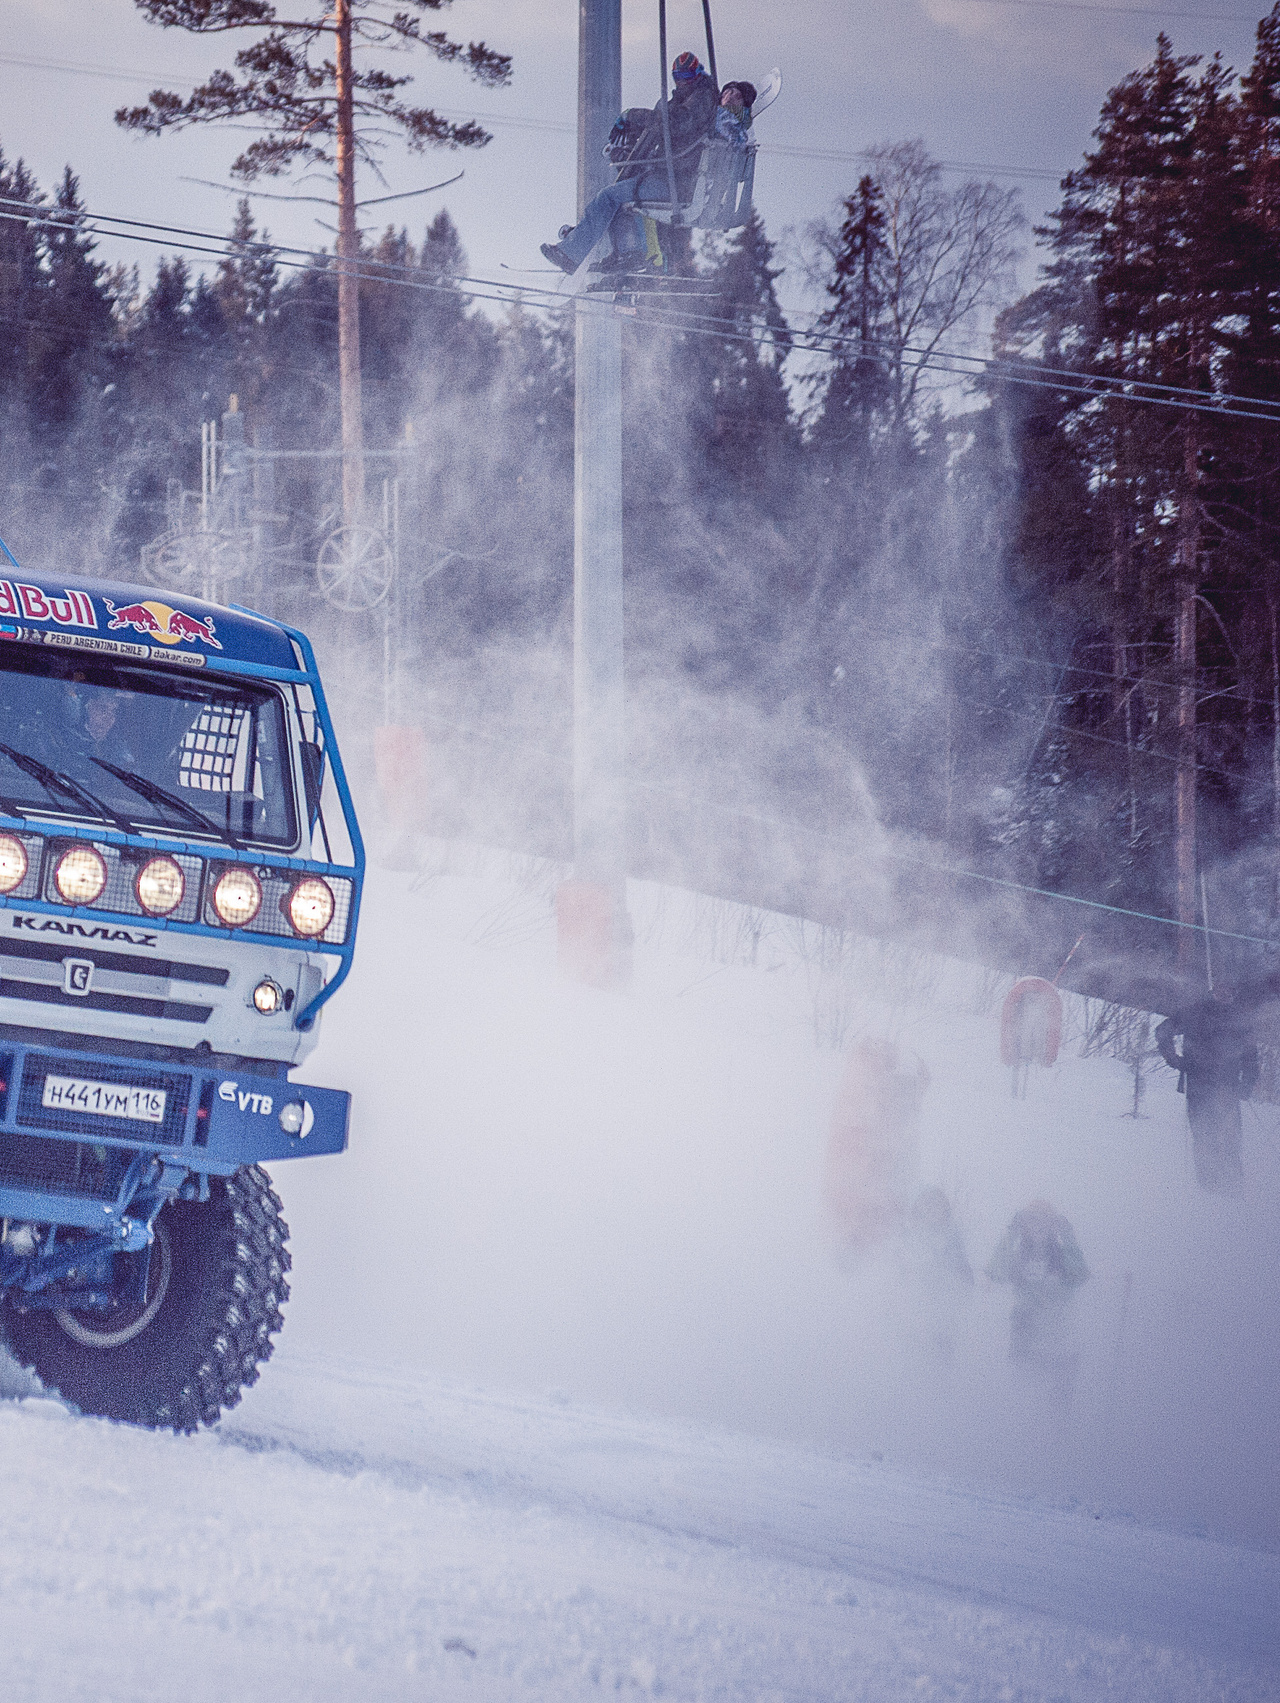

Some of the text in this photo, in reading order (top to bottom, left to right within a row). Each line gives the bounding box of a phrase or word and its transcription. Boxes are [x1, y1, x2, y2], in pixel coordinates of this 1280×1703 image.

[50, 633, 143, 656] PERU ARGENTINA CHILE
[153, 649, 202, 666] dakar.com
[13, 916, 157, 948] KAMAZ
[132, 1092, 161, 1111] 116
[237, 1090, 273, 1116] VTB
